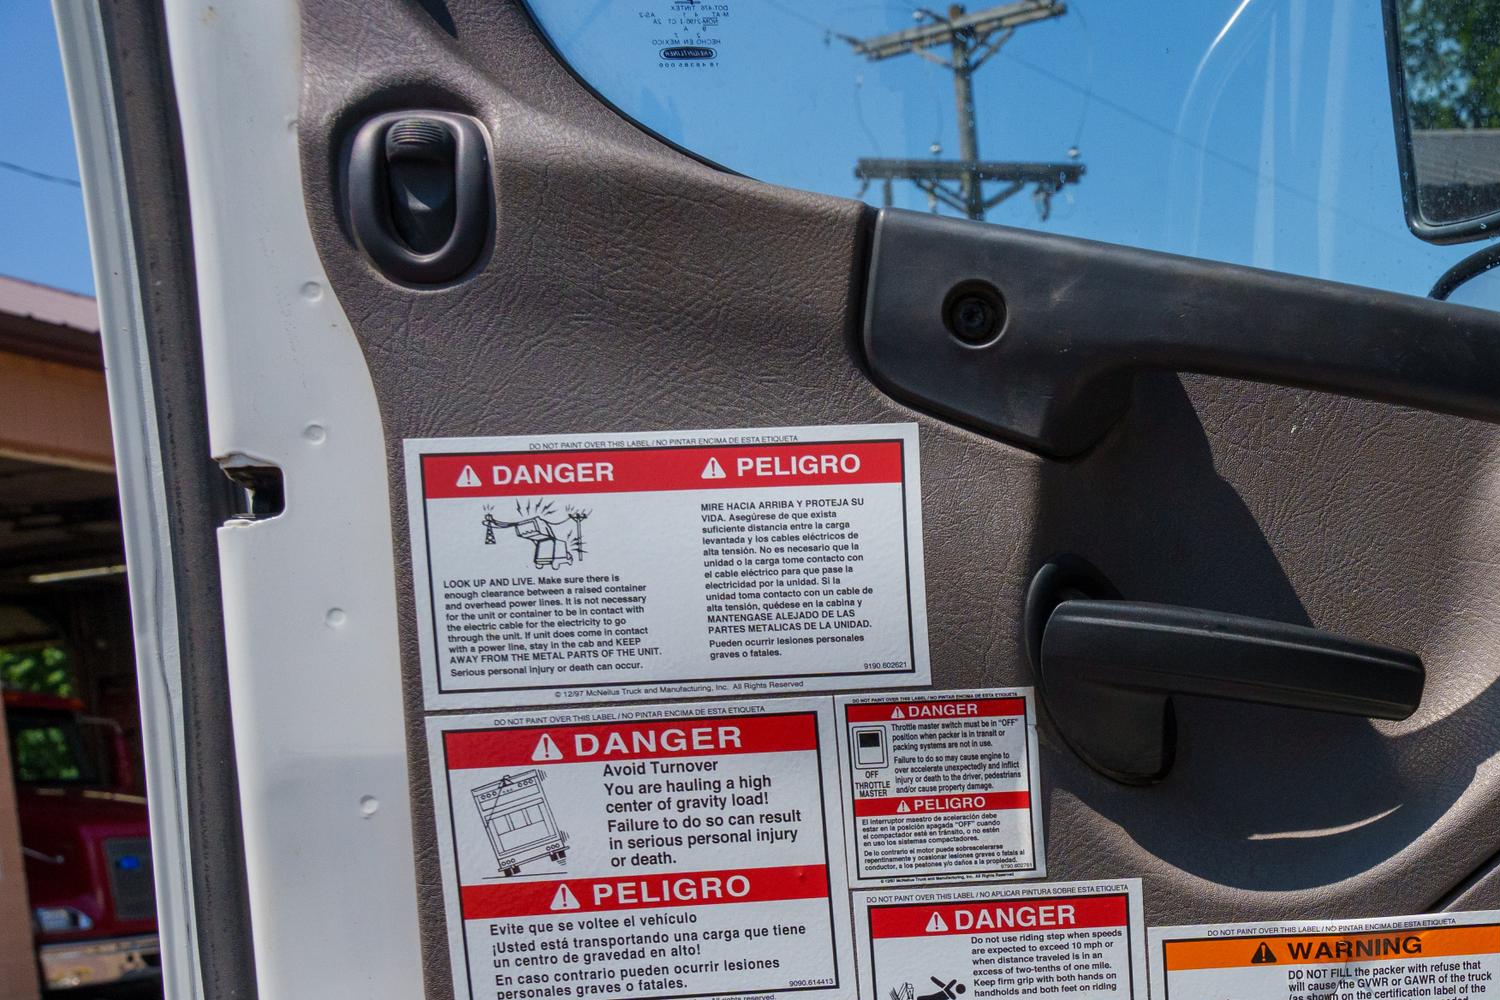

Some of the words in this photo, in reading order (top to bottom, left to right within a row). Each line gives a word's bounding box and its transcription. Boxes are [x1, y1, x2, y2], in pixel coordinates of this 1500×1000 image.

[492, 462, 614, 485] DANGER
[737, 453, 860, 477] PELIGRO
[700, 502, 724, 511] MIRE
[726, 501, 756, 510] HACIA
[758, 500, 794, 509] ARRIBA
[796, 499, 803, 508] Y
[805, 498, 849, 507] PROTEJA
[851, 497, 864, 506] SU
[443, 579, 471, 589] LOOK
[473, 578, 486, 588] UP
[489, 577, 509, 587] AND
[511, 577, 535, 586] LIVE.
[537, 576, 562, 585] Make
[563, 576, 584, 584] sure
[585, 574, 609, 583] there
[611, 574, 620, 582] is
[908, 703, 978, 717] DANGER
[574, 726, 742, 756] DANGER
[603, 761, 646, 777] Avoid
[649, 760, 718, 774] Turnover
[864, 770, 879, 779] OFF
[603, 782, 633, 796] You
[638, 783, 662, 794] are
[666, 777, 721, 793] hauling
[726, 779, 735, 789] a
[738, 774, 771, 791] high
[855, 781, 891, 789] THROTTLE
[859, 789, 888, 797] MASTER
[605, 799, 653, 814] center
[657, 796, 672, 811] of
[676, 794, 727, 812] gravity
[731, 791, 768, 806] load!
[913, 796, 986, 811] PELIGRO
[607, 818, 659, 833] Failure
[662, 817, 678, 829] to
[682, 815, 701, 828] do
[705, 816, 724, 827] so
[728, 814, 755, 826] can
[759, 809, 801, 824] result
[609, 836, 623, 850] in
[627, 834, 683, 849] serious
[687, 828, 752, 849] personal
[756, 827, 798, 844] injury
[610, 856, 626, 867] or
[630, 851, 677, 866] death.
[592, 874, 750, 905] PELIGRO
[489, 923, 524, 936] Evite
[528, 922, 553, 936] que
[558, 921, 574, 931] se
[577, 917, 619, 930] voltee
[623, 915, 635, 927] el
[639, 911, 697, 926] vehículo
[954, 904, 1075, 930] DANGER
[970, 936, 983, 944] Do
[985, 935, 1000, 943] not
[1001, 935, 1017, 943] use
[1019, 933, 1044, 943] riding
[1046, 932, 1065, 941] step
[1066, 931, 1090, 939] when
[1091, 928, 1122, 939] speeds
[1287, 935, 1422, 960] WARNING
[575, 983, 621, 998] graves
[625, 982, 634, 992] o
[637, 977, 687, 991] fatales.
